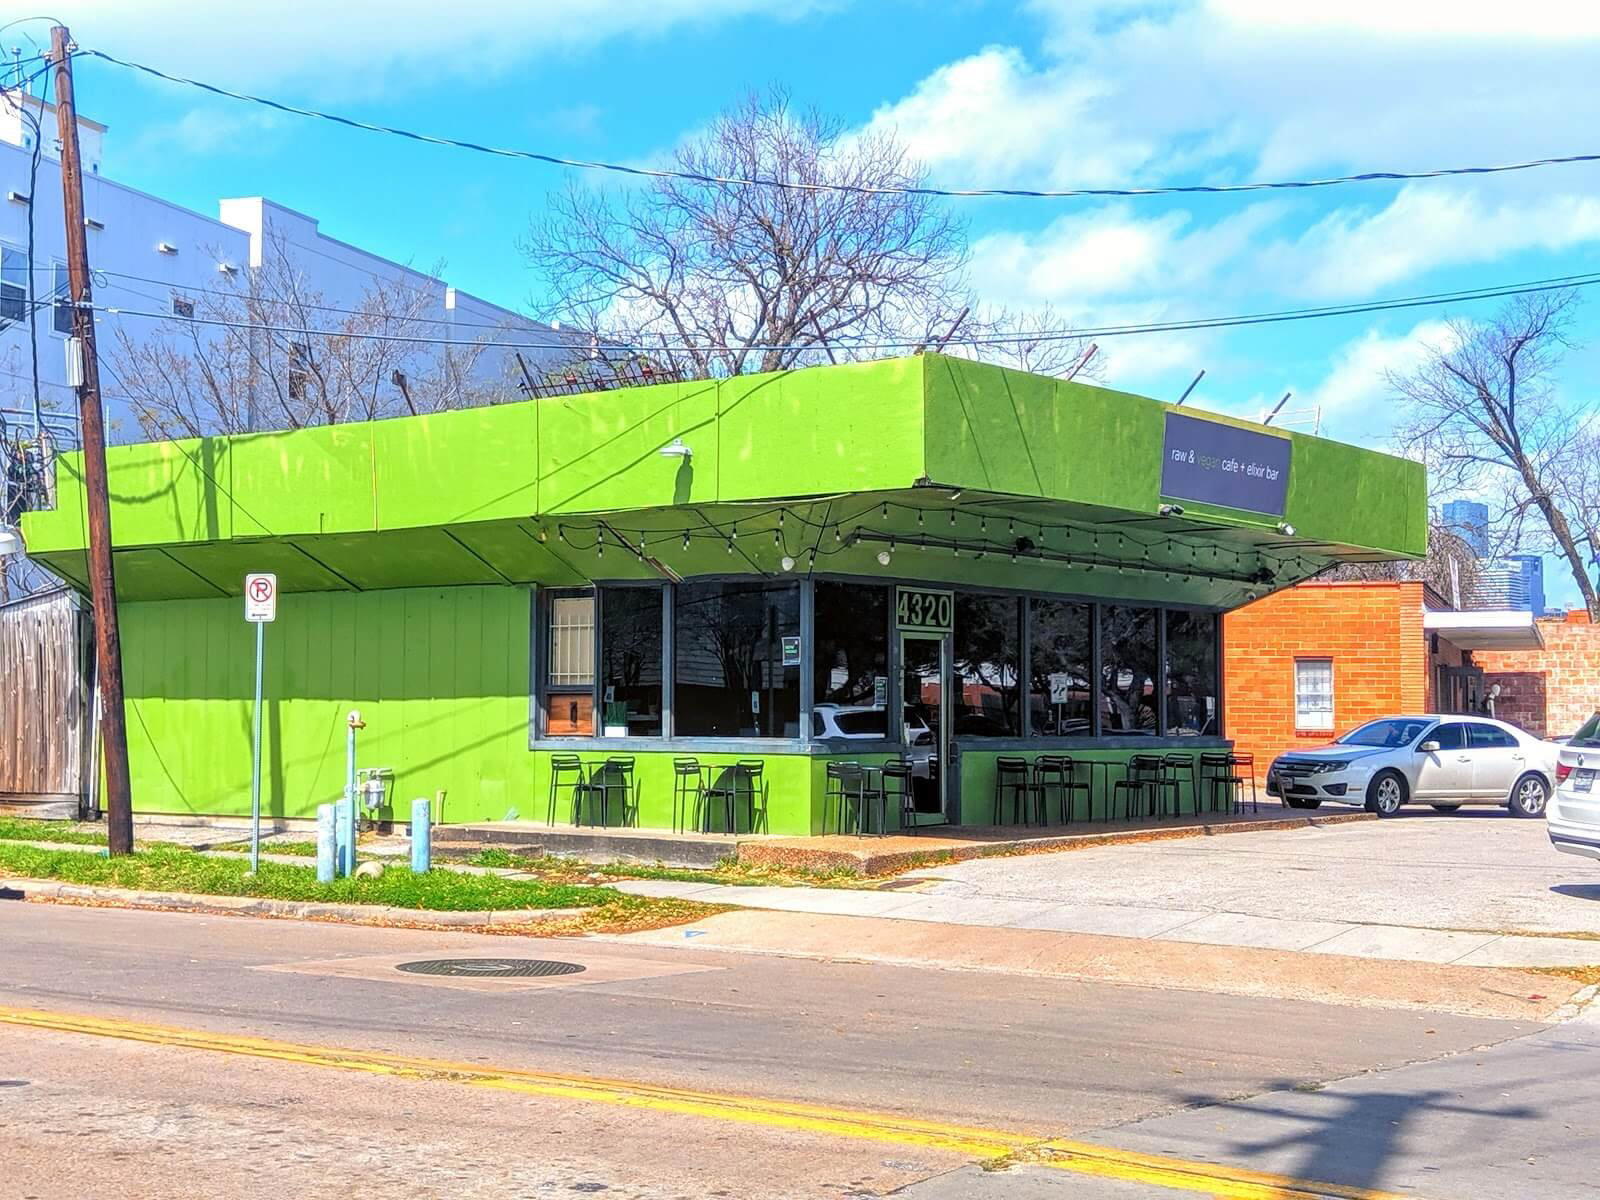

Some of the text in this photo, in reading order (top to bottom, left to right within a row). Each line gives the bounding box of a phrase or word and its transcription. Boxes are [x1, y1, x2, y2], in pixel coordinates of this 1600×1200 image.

[1171, 449, 1187, 462] raw
[1188, 449, 1195, 463] &
[1221, 458, 1239, 473] cafe
[1246, 463, 1265, 477] elixir
[1266, 466, 1279, 480] bar
[897, 592, 951, 626] 4320
